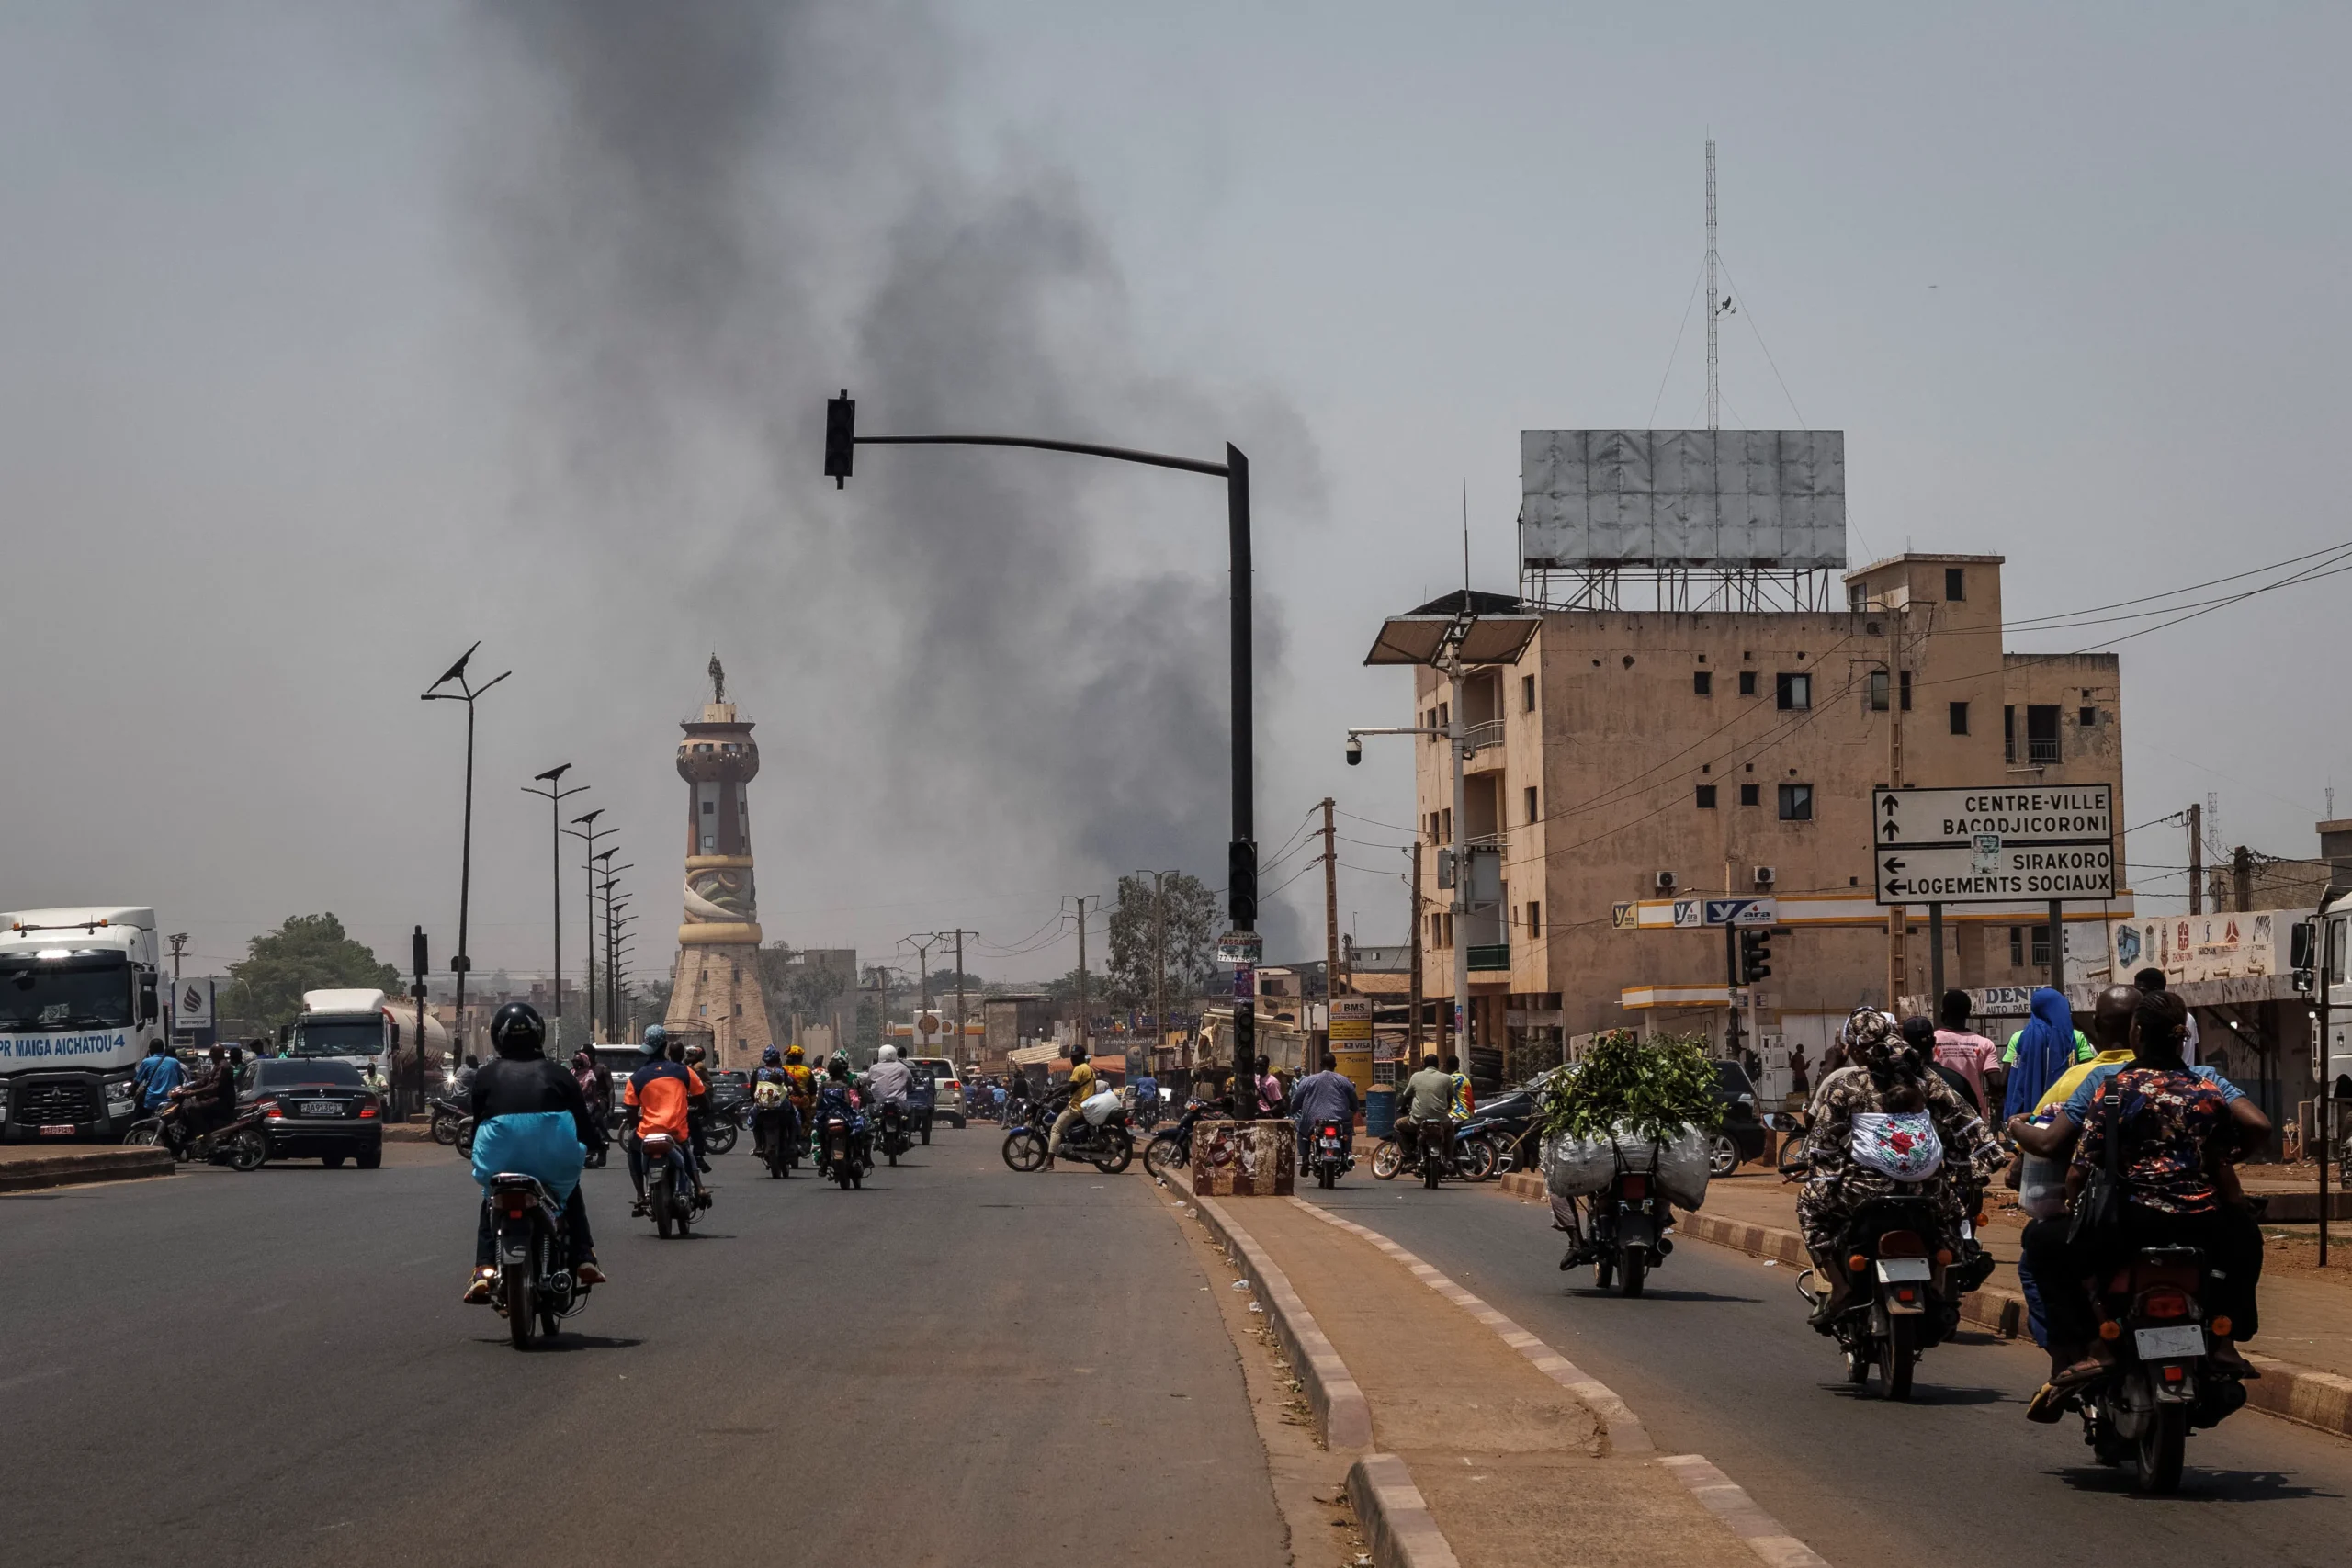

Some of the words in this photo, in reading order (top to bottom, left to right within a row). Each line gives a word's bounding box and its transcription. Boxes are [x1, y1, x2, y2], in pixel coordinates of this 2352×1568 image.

[1965, 794, 2106, 812] CENTRE-VILLE
[1943, 816, 2107, 835] BACODJICORONI
[2013, 852, 2109, 870] SIRAKORO
[1908, 876, 2022, 895] LOGEMENTS
[2028, 874, 2110, 892] SOCIAUX
[1343, 1003, 1365, 1011] BMS
[1986, 1005, 2007, 1014] AUTO
[16, 1039, 52, 1057] MAIGA
[55, 1034, 112, 1055] AICHATOU
[114, 1034, 125, 1047] 4
[305, 1103, 339, 1111] AA913CD
